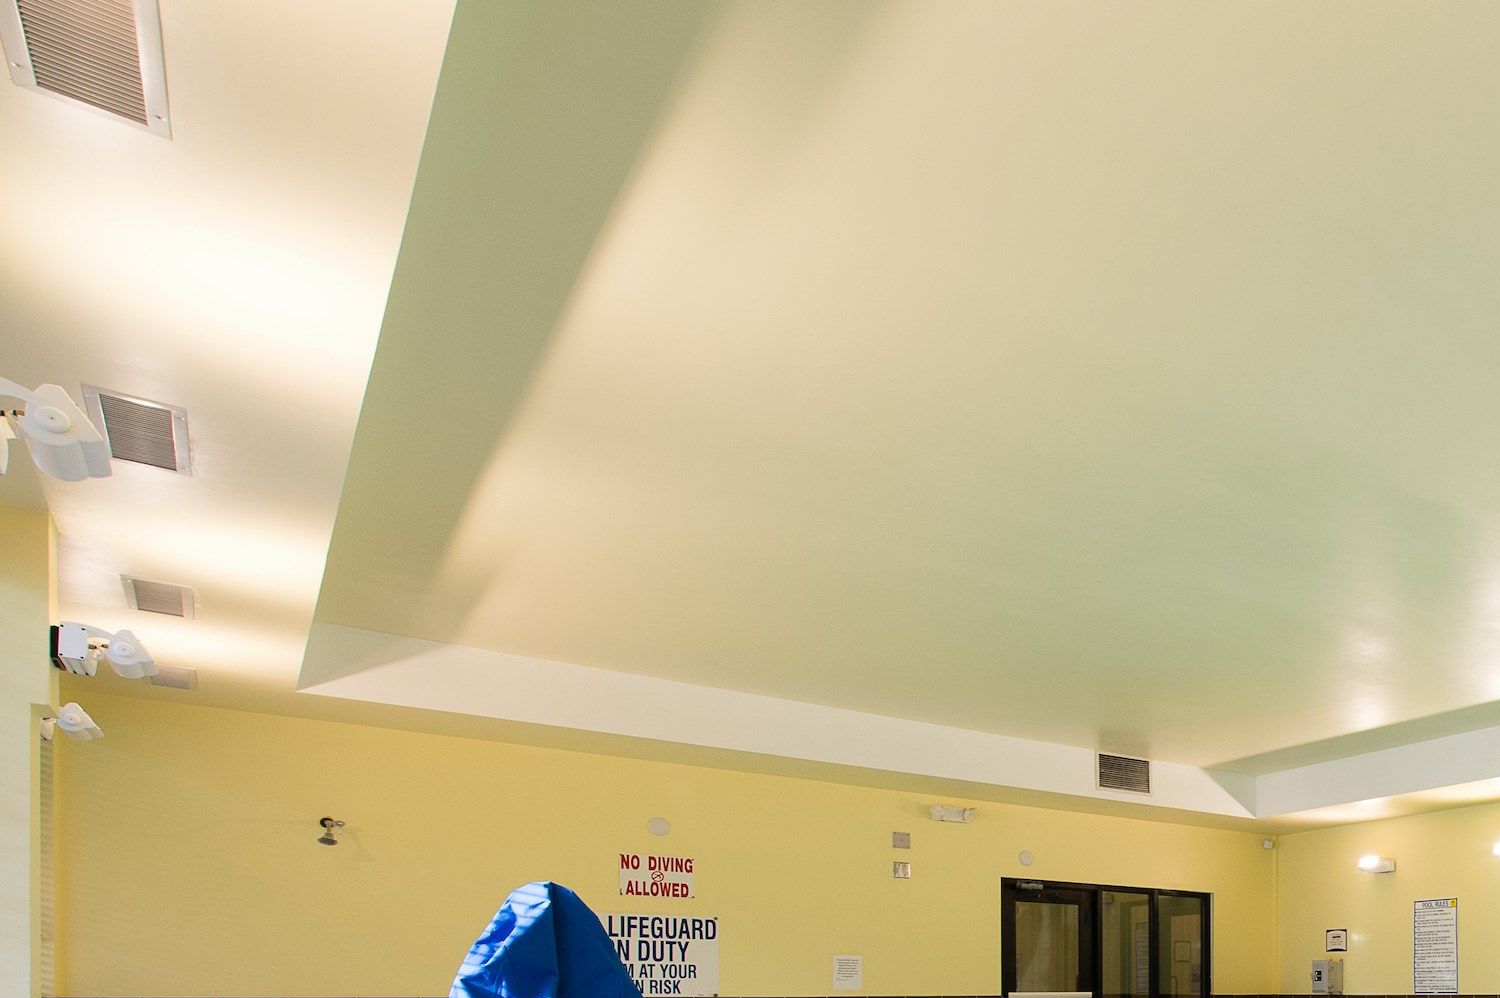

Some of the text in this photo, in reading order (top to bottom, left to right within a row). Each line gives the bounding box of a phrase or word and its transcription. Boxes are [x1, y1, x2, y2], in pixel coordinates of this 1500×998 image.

[620, 854, 693, 873] NO DIVING
[625, 880, 689, 898] ALLOWED
[1422, 900, 1449, 909] POOL RULES
[608, 915, 717, 940] LIFEGUARD
[616, 939, 690, 962] N DUTY
[639, 964, 655, 978] AT
[660, 964, 697, 979] YOUR
[650, 980, 681, 994] RISK
